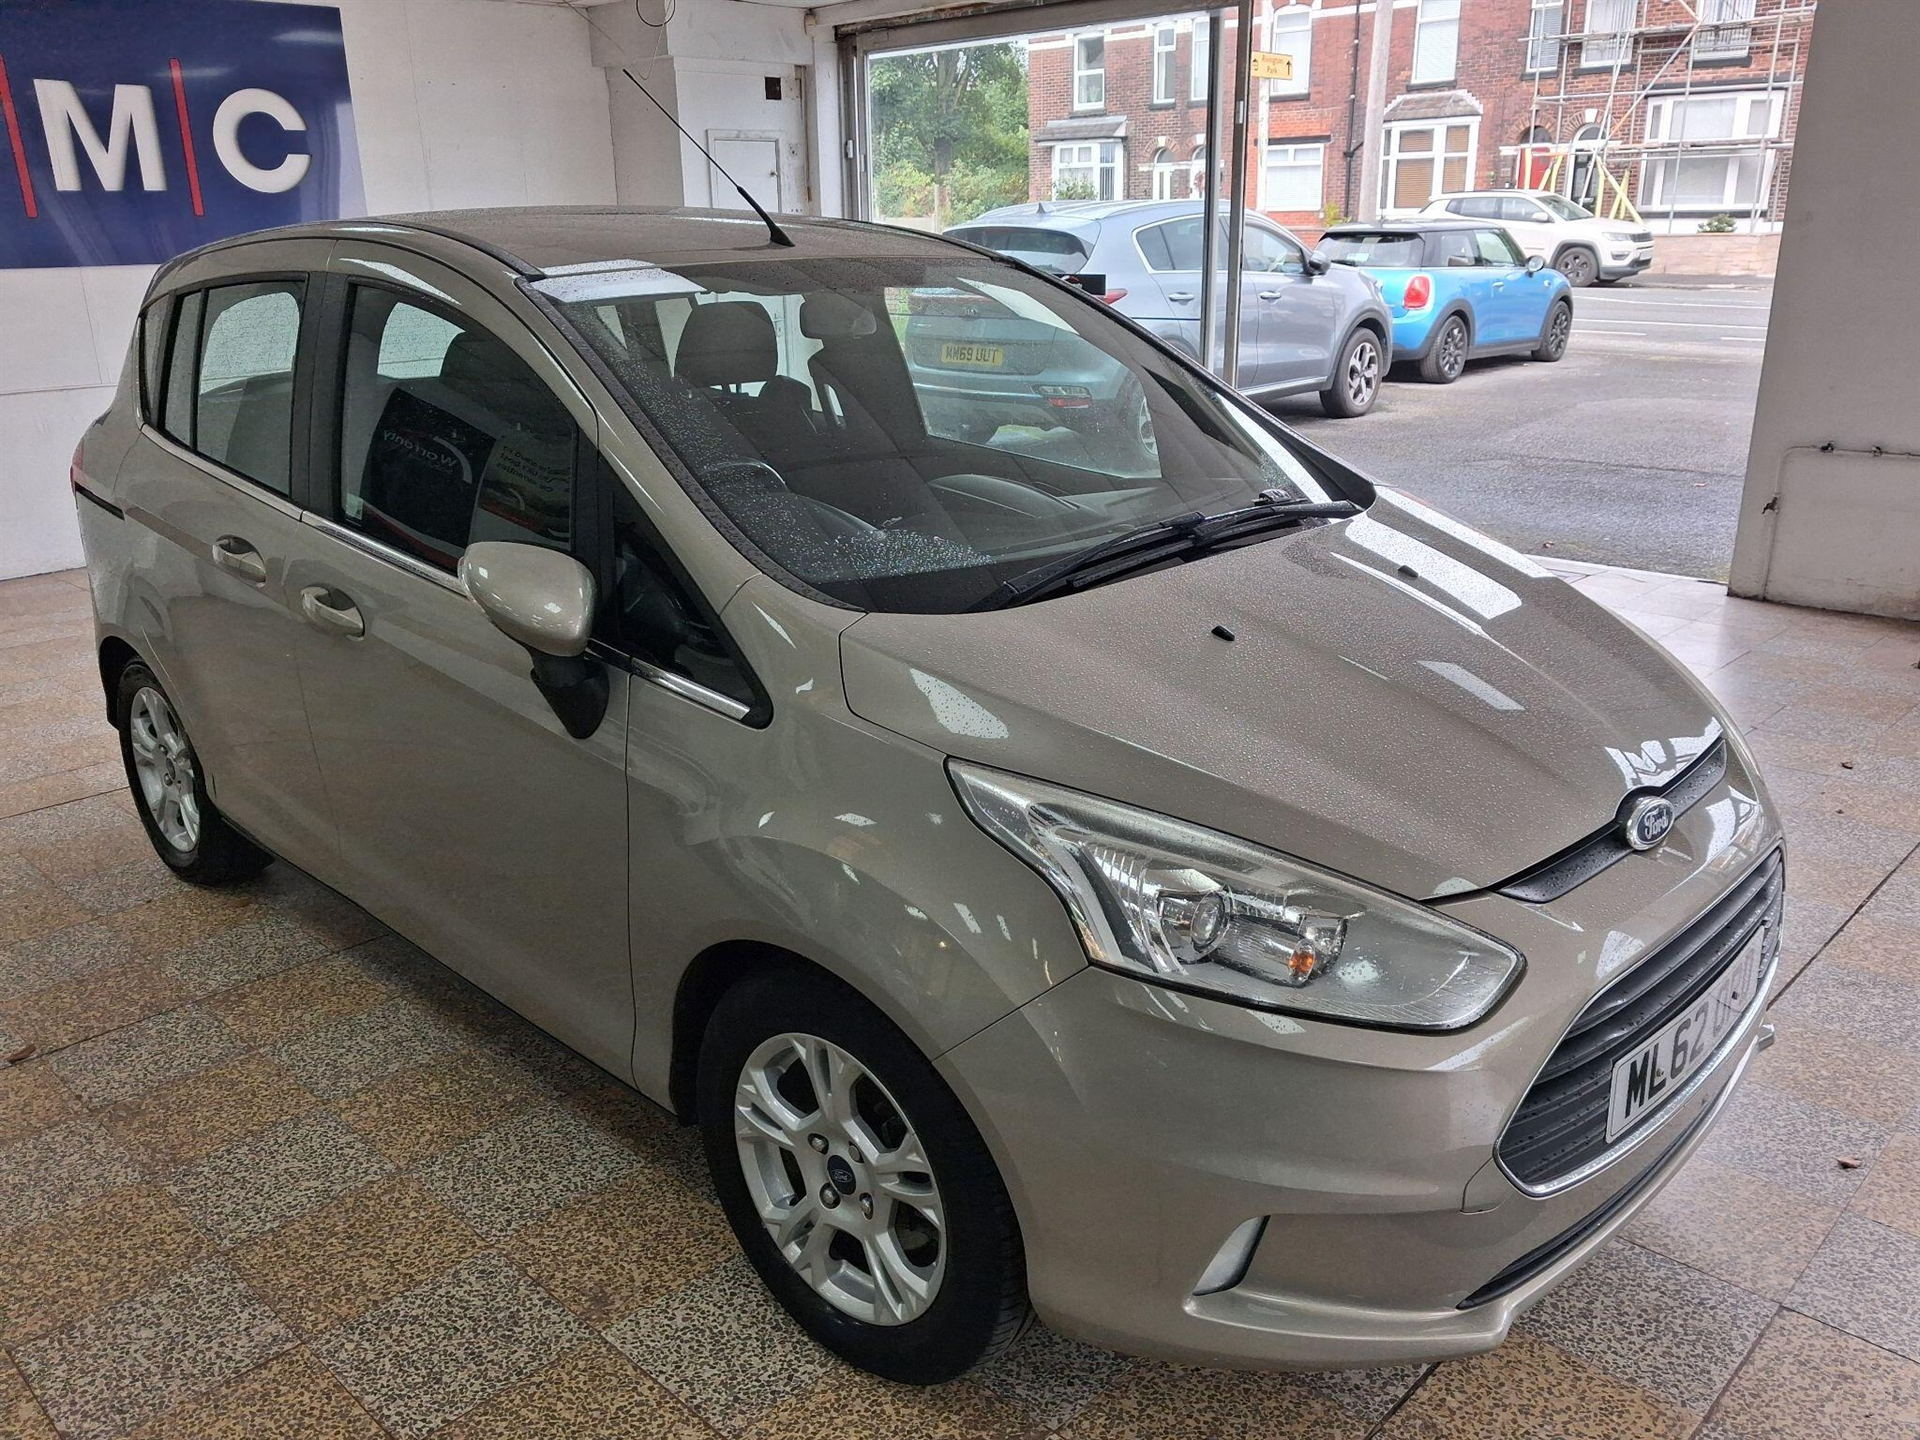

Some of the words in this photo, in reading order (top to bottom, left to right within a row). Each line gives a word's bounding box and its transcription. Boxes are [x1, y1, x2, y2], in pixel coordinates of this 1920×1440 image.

[33, 78, 168, 192] M
[212, 87, 313, 194] C
[1645, 808, 1668, 839] Ford
[1625, 1001, 1709, 1119] ML62
